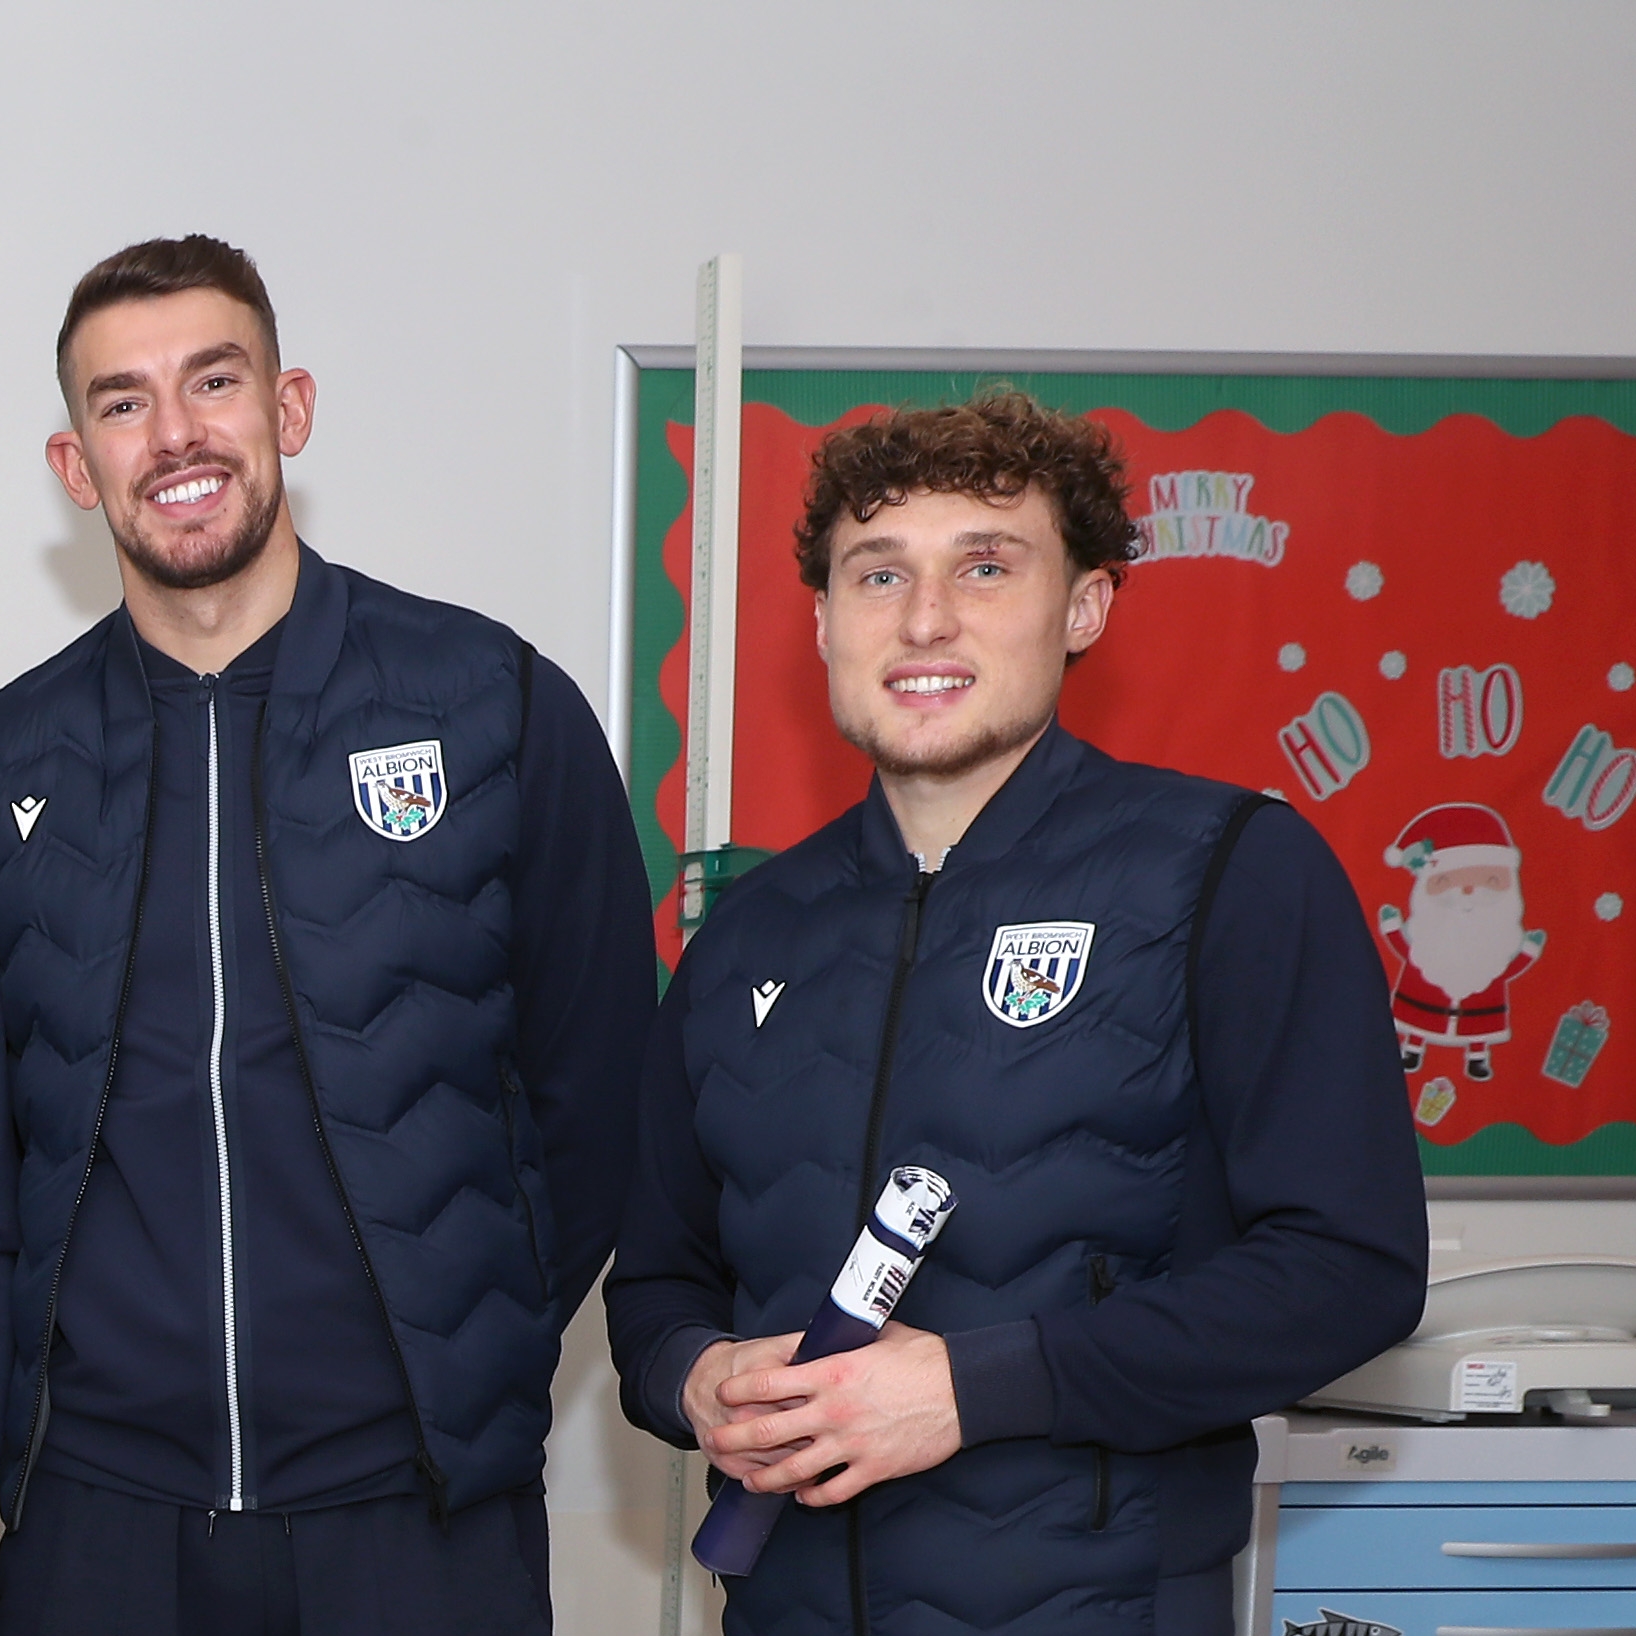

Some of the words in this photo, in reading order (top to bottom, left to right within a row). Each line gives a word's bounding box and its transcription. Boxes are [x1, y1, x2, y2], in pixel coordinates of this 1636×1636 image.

[1154, 474, 1248, 512] MERRY
[1139, 514, 1284, 561] HRISTMAS
[1442, 668, 1517, 752] HO
[1282, 696, 1362, 796] HO
[362, 756, 433, 779] ALBION
[1546, 727, 1636, 822] HO
[1001, 940, 1079, 956] ALBION
[1347, 1445, 1389, 1464] Agile
